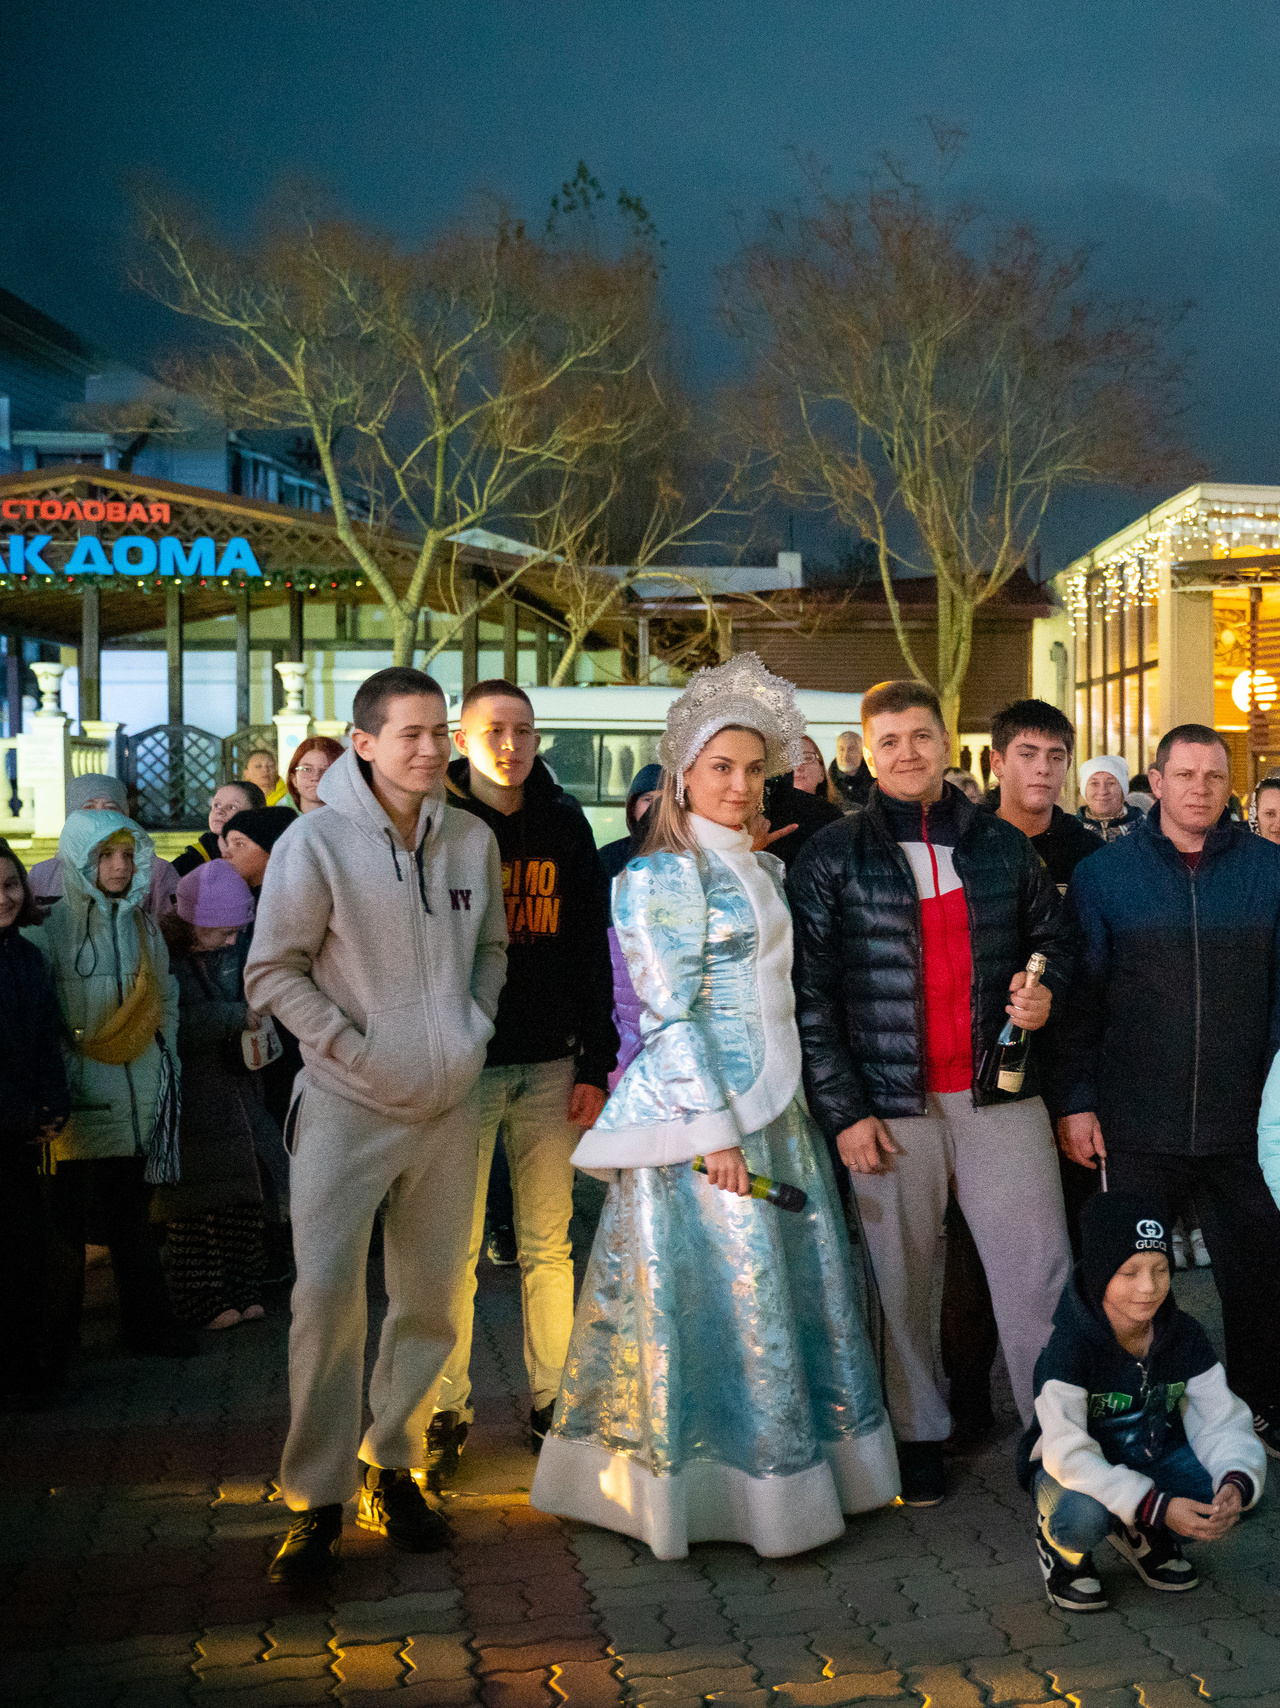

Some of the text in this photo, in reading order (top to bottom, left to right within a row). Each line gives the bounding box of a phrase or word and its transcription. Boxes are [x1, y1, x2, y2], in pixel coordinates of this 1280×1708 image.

[2, 499, 171, 524] СТОЛОВАЯ
[0, 534, 263, 577] К ДОМА
[448, 888, 472, 911] NY
[1135, 1239, 1167, 1252] GUCCI
